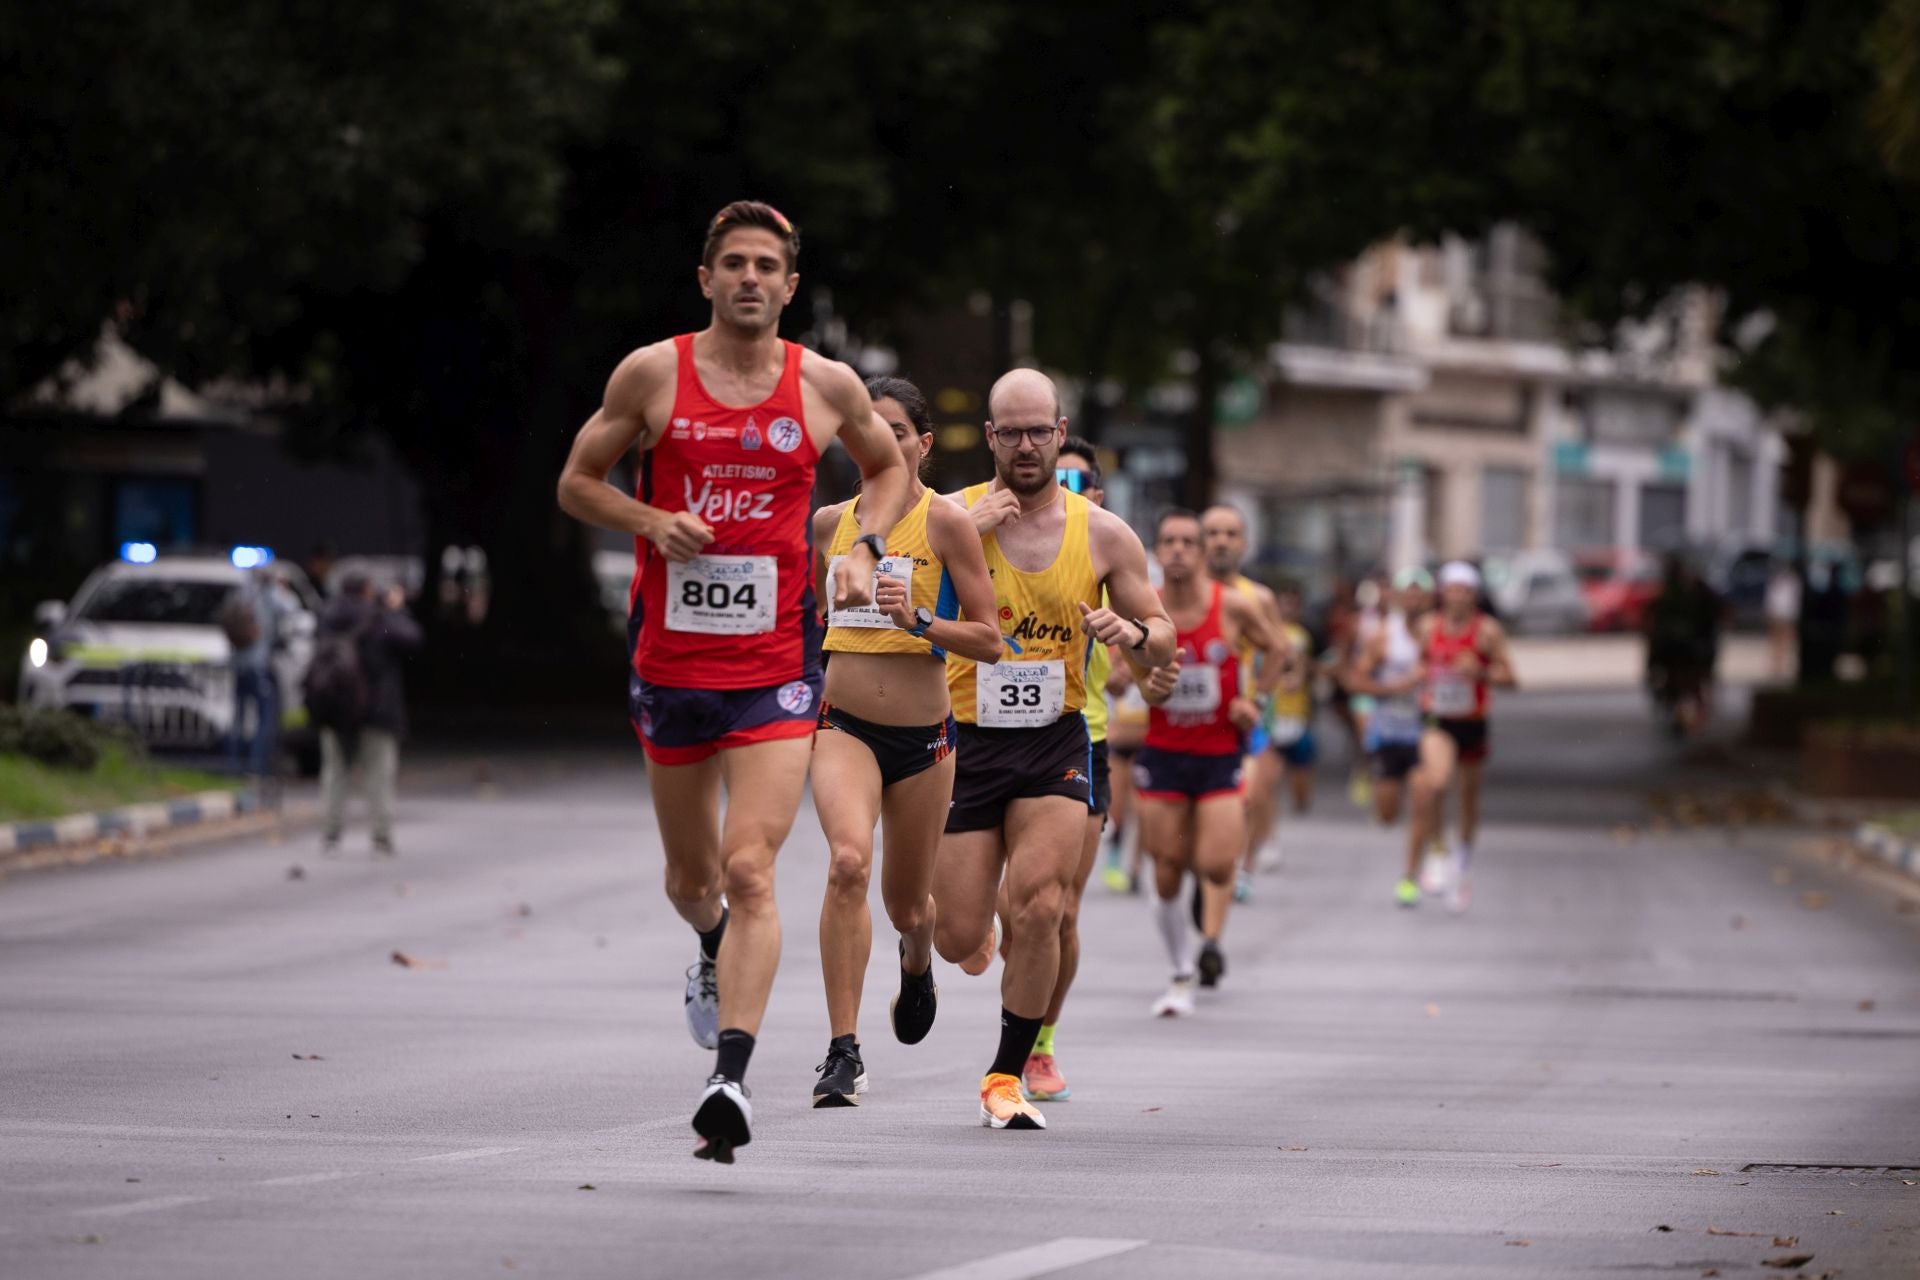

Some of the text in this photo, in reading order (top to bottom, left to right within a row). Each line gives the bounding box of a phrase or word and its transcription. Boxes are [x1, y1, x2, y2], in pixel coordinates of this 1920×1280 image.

[702, 464, 777, 481] ATLETISMO
[682, 581, 757, 610] 804
[1013, 611, 1073, 642] Álora
[1000, 684, 1041, 707] 33
